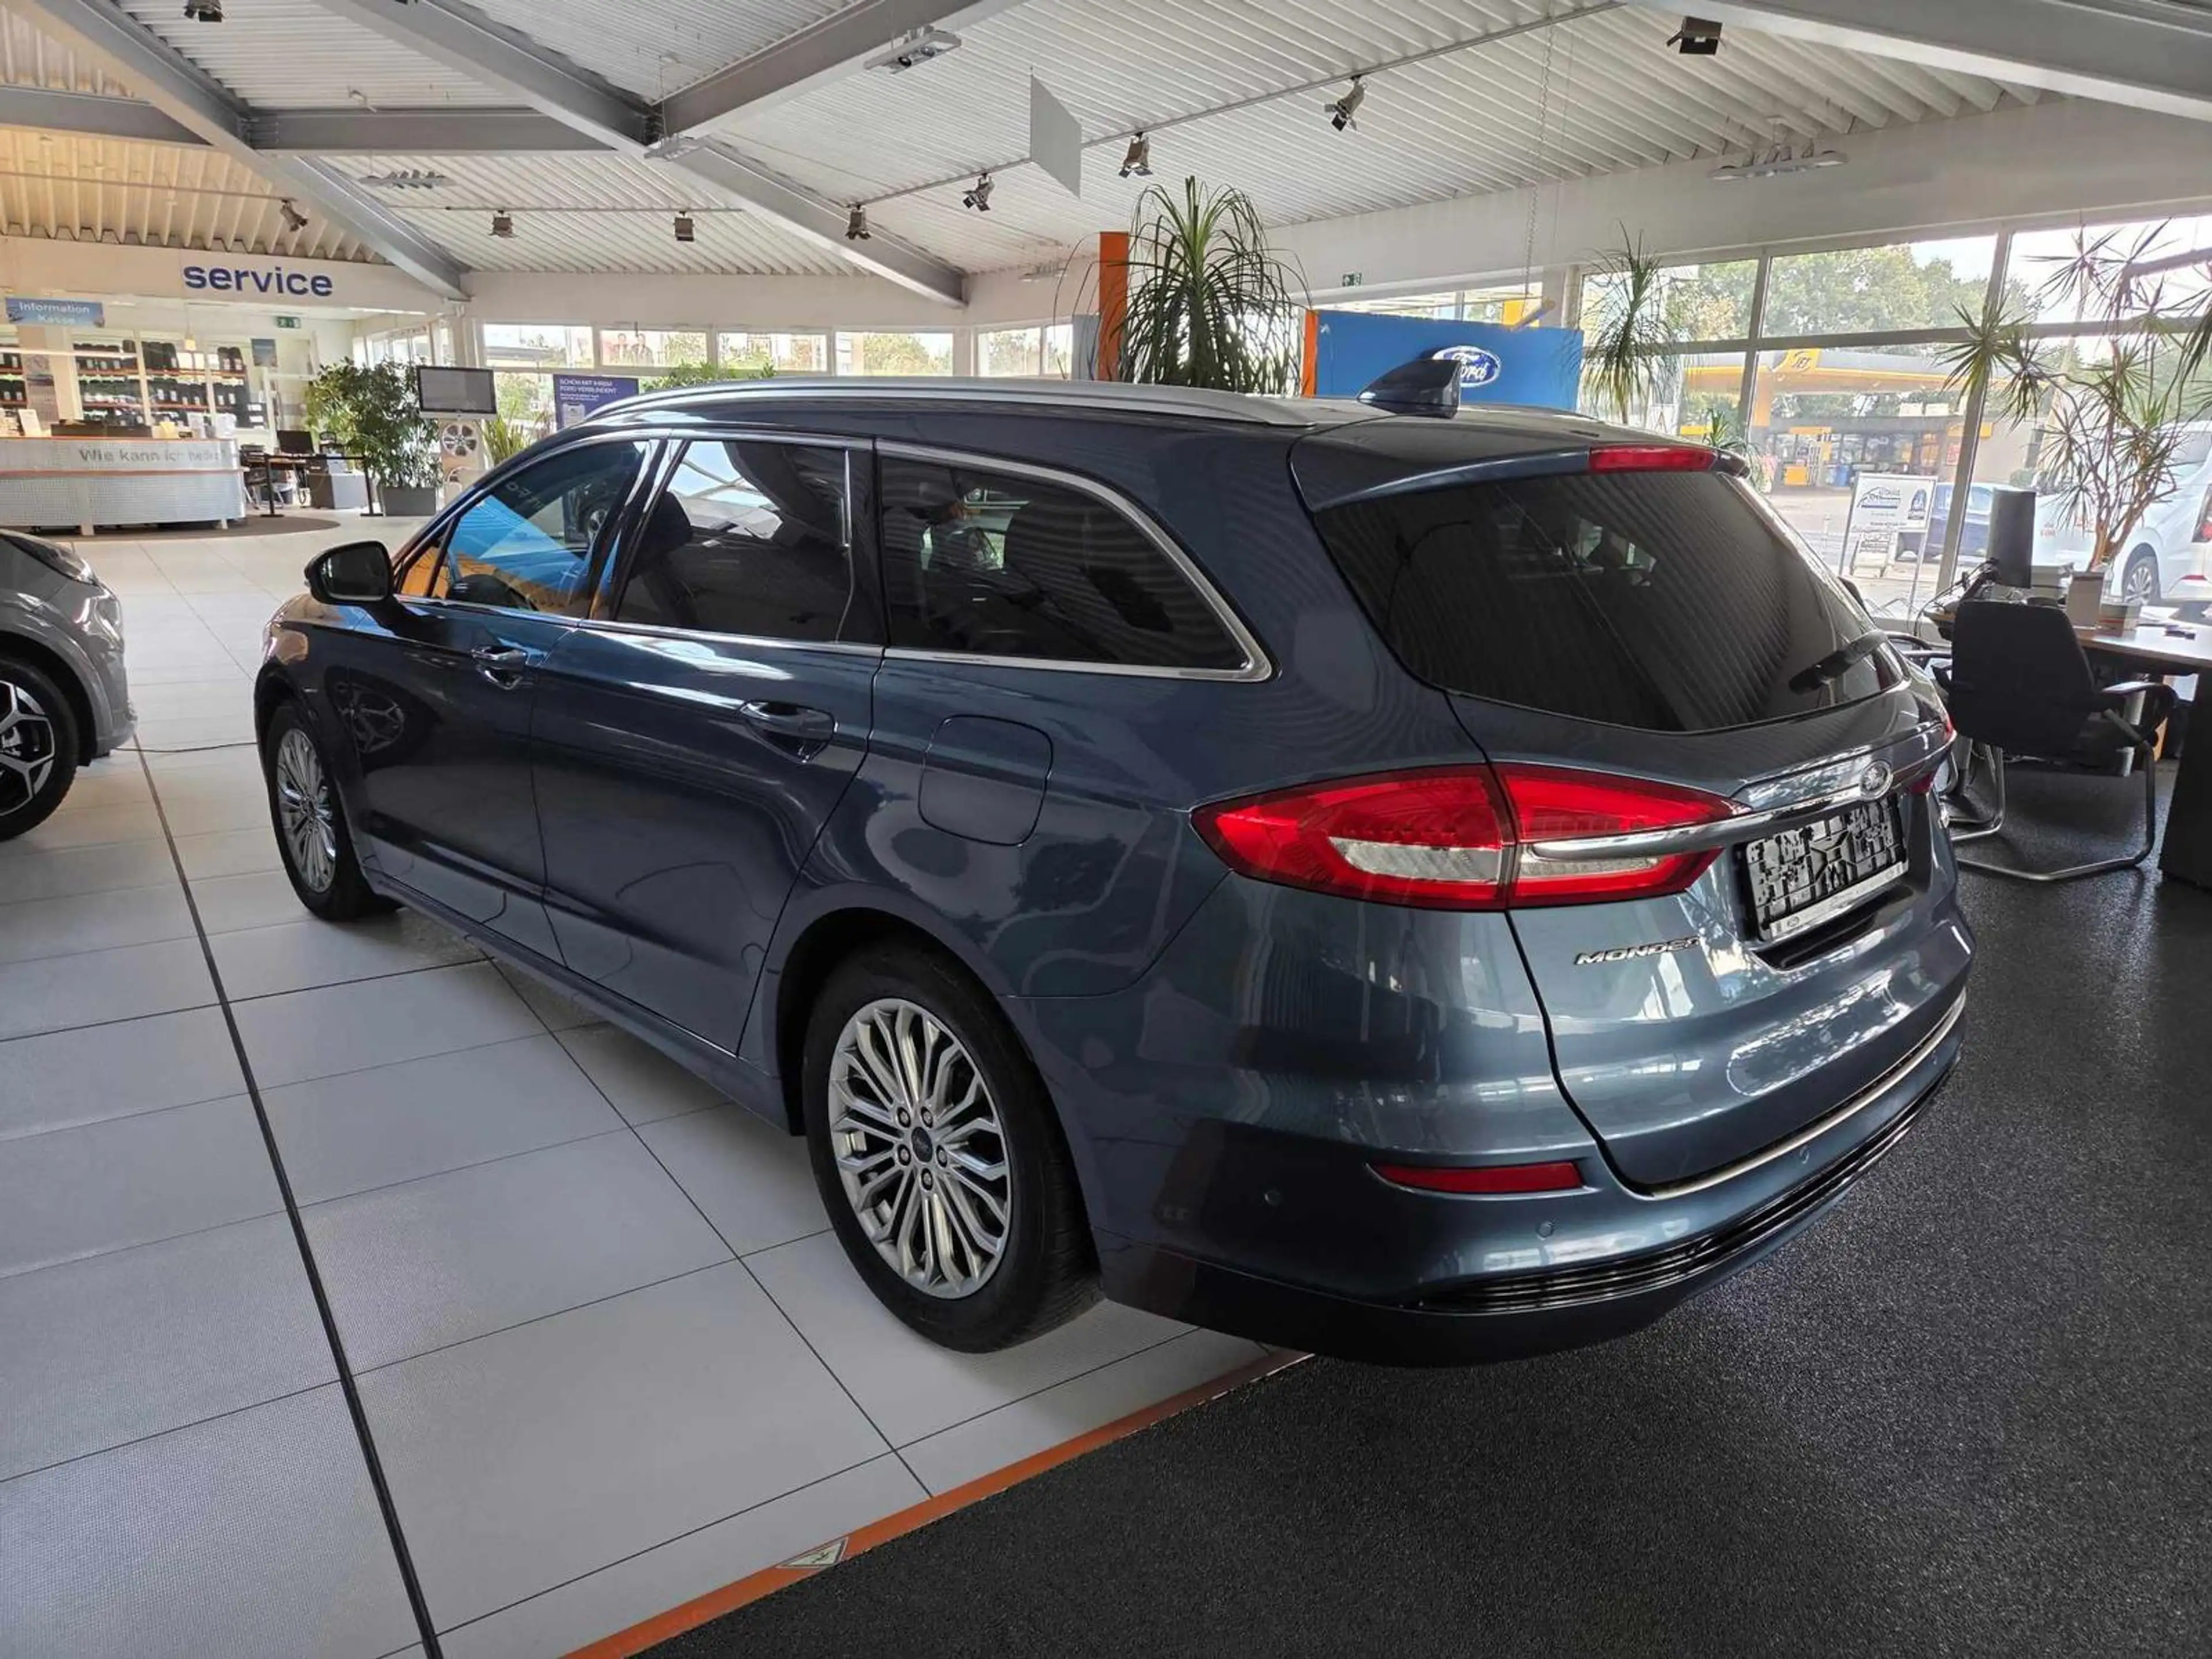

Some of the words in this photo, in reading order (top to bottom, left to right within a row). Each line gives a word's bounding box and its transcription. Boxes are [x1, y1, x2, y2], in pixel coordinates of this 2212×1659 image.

[183, 266, 332, 297] service
[19, 301, 89, 314] Information
[79, 449, 113, 462] Wie
[119, 449, 160, 462] kann
